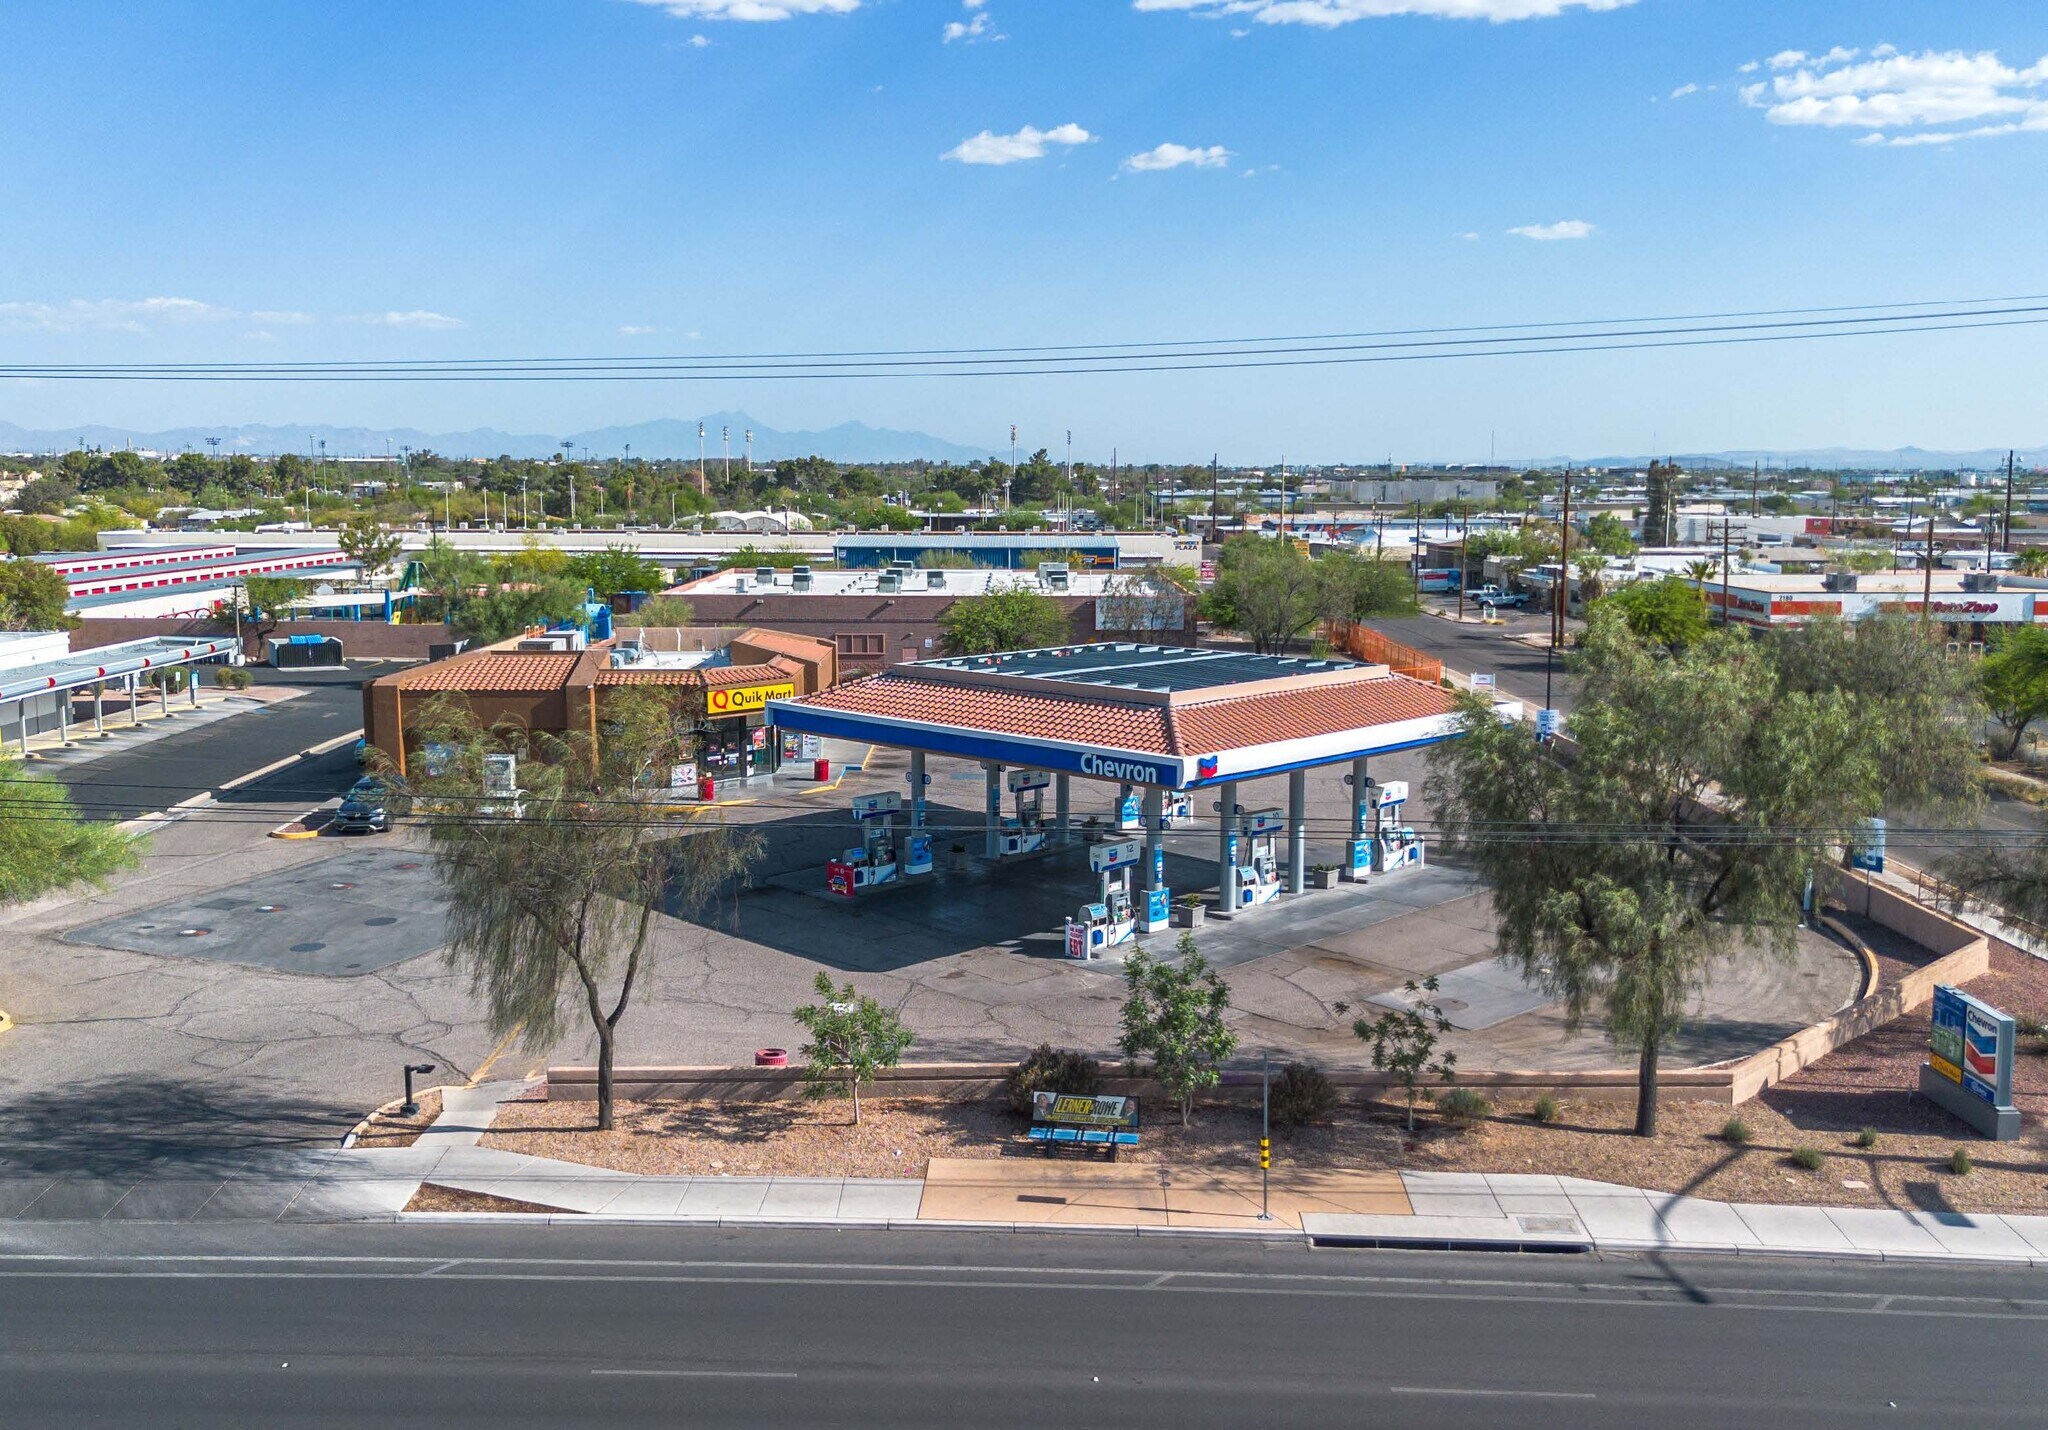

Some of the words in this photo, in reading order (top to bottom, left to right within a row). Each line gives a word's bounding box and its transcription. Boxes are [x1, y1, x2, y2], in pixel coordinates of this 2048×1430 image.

[732, 691, 763, 707] Quik
[765, 690, 792, 701] Mart
[1080, 752, 1157, 783] Chevron
[1126, 845, 1134, 853] 12
[1070, 938, 1083, 956] EBT
[1967, 1010, 1998, 1034] Chevron
[1056, 1098, 1092, 1114] LERNER
[1093, 1100, 1119, 1116] ROWE
